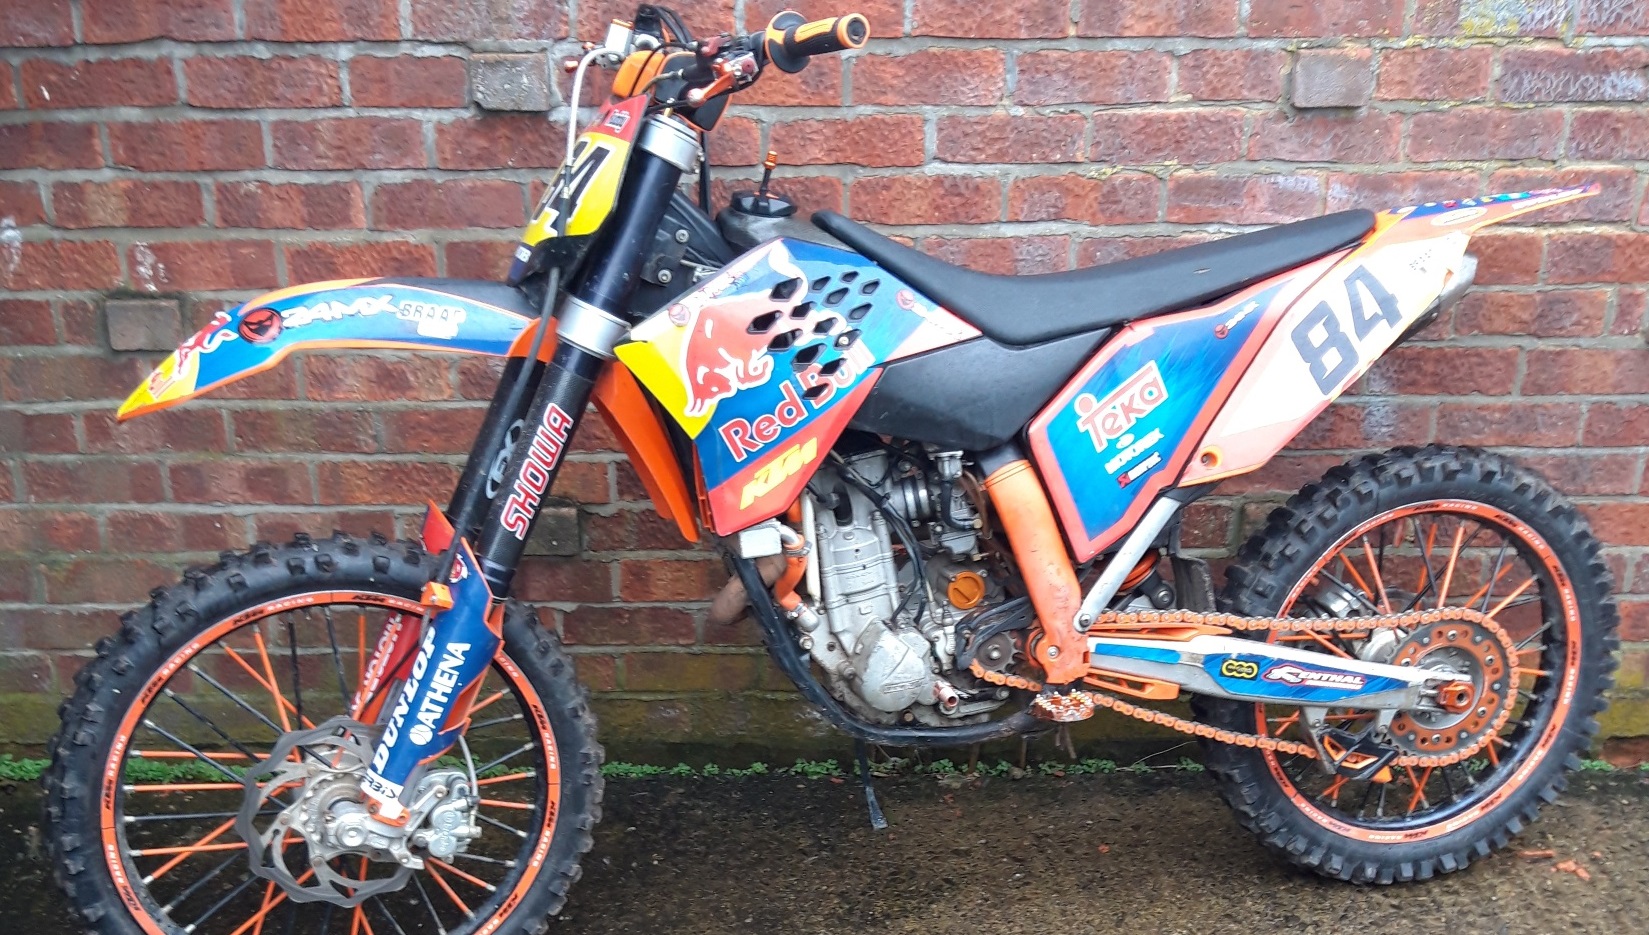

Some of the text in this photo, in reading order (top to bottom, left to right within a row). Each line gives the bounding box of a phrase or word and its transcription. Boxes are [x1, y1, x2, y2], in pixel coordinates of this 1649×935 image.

[1290, 264, 1403, 397] 84
[718, 381, 808, 463] Red
[500, 402, 574, 541] SHOWA
[740, 436, 818, 511] KTM
[388, 599, 425, 612] RACIN
[162, 642, 200, 676] RACING
[415, 642, 472, 730] ATHENA
[372, 626, 436, 776] DUNLOP
[108, 735, 126, 777] RACING
[543, 732, 557, 770] RACING
